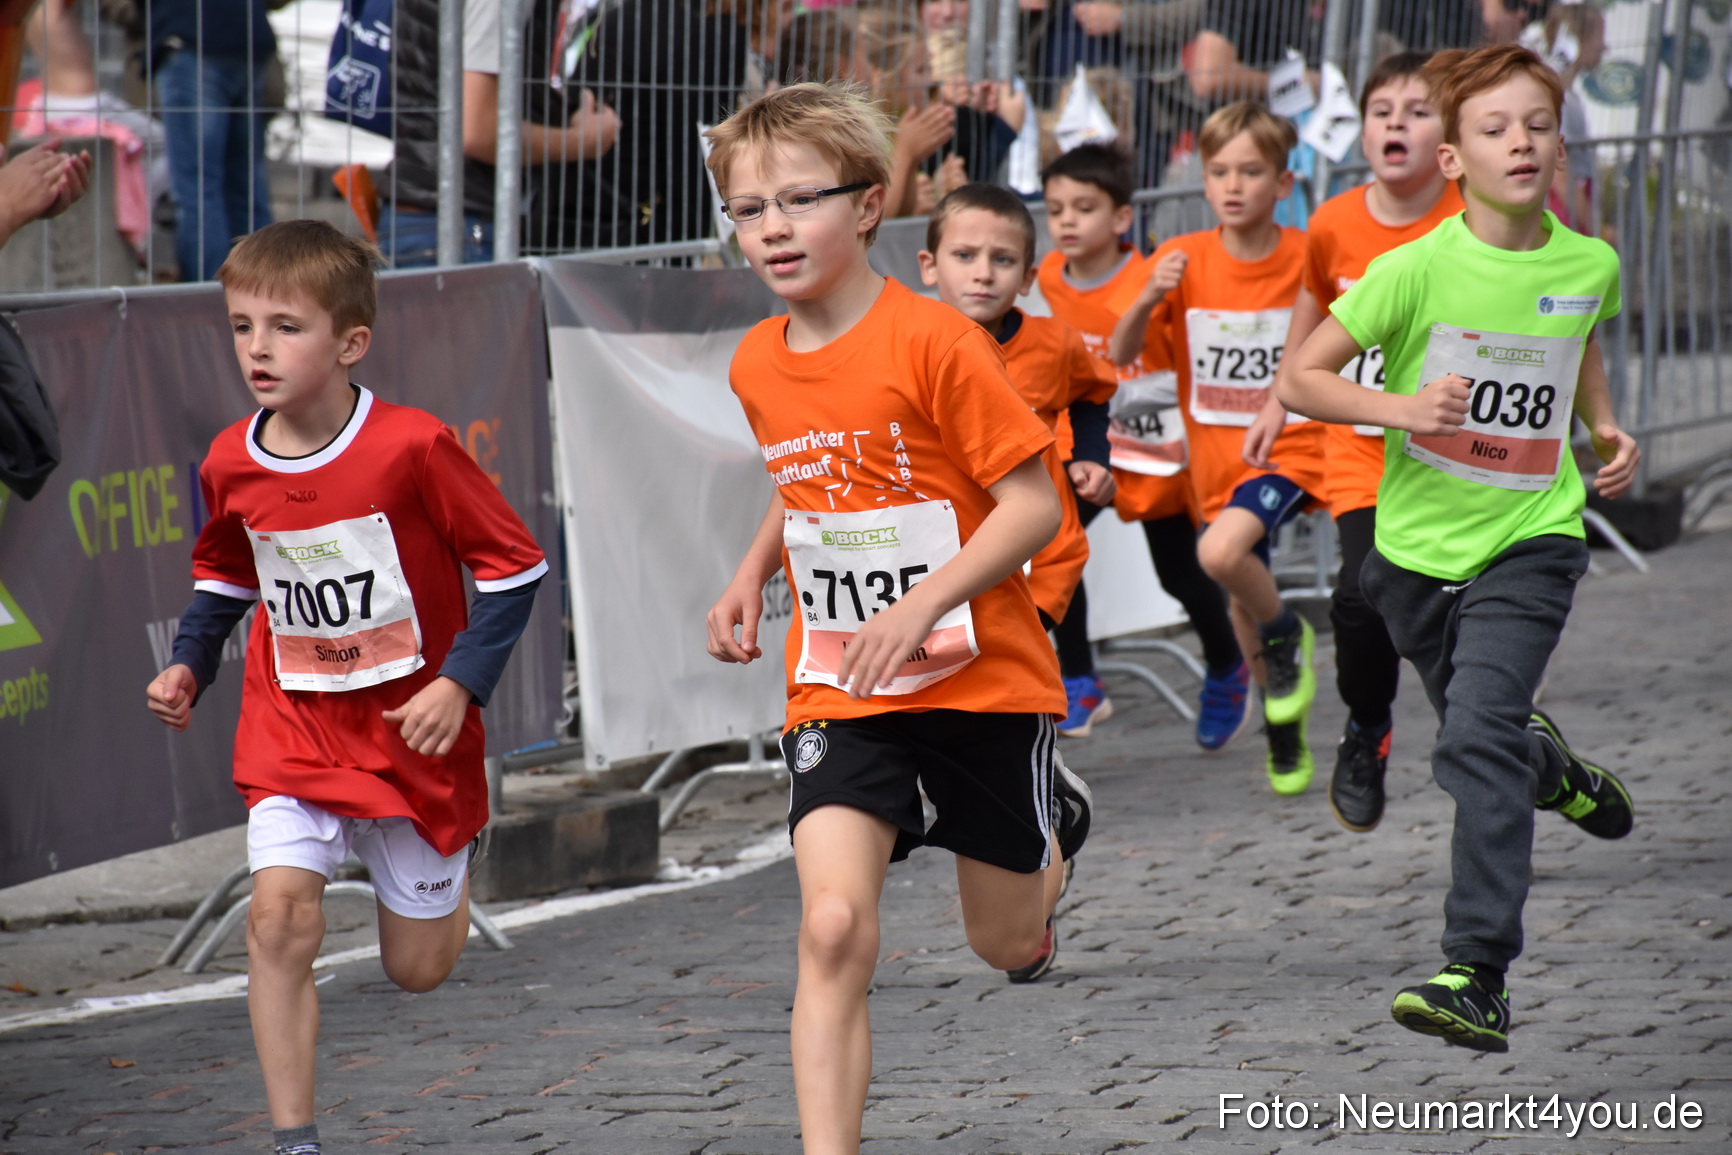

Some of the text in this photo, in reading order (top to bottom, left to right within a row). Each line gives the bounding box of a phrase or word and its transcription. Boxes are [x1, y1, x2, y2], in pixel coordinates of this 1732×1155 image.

[1492, 347, 1546, 363] BOCK
[1448, 373, 1556, 430] 038
[1470, 440, 1508, 461] Nico
[770, 454, 832, 487] tadtlauf
[69, 464, 184, 559] OFFICE
[835, 526, 900, 546] BOCK
[284, 540, 343, 561] BOCK
[274, 569, 375, 628] 7007
[315, 645, 361, 663] Simon
[429, 878, 453, 892] JAKO
